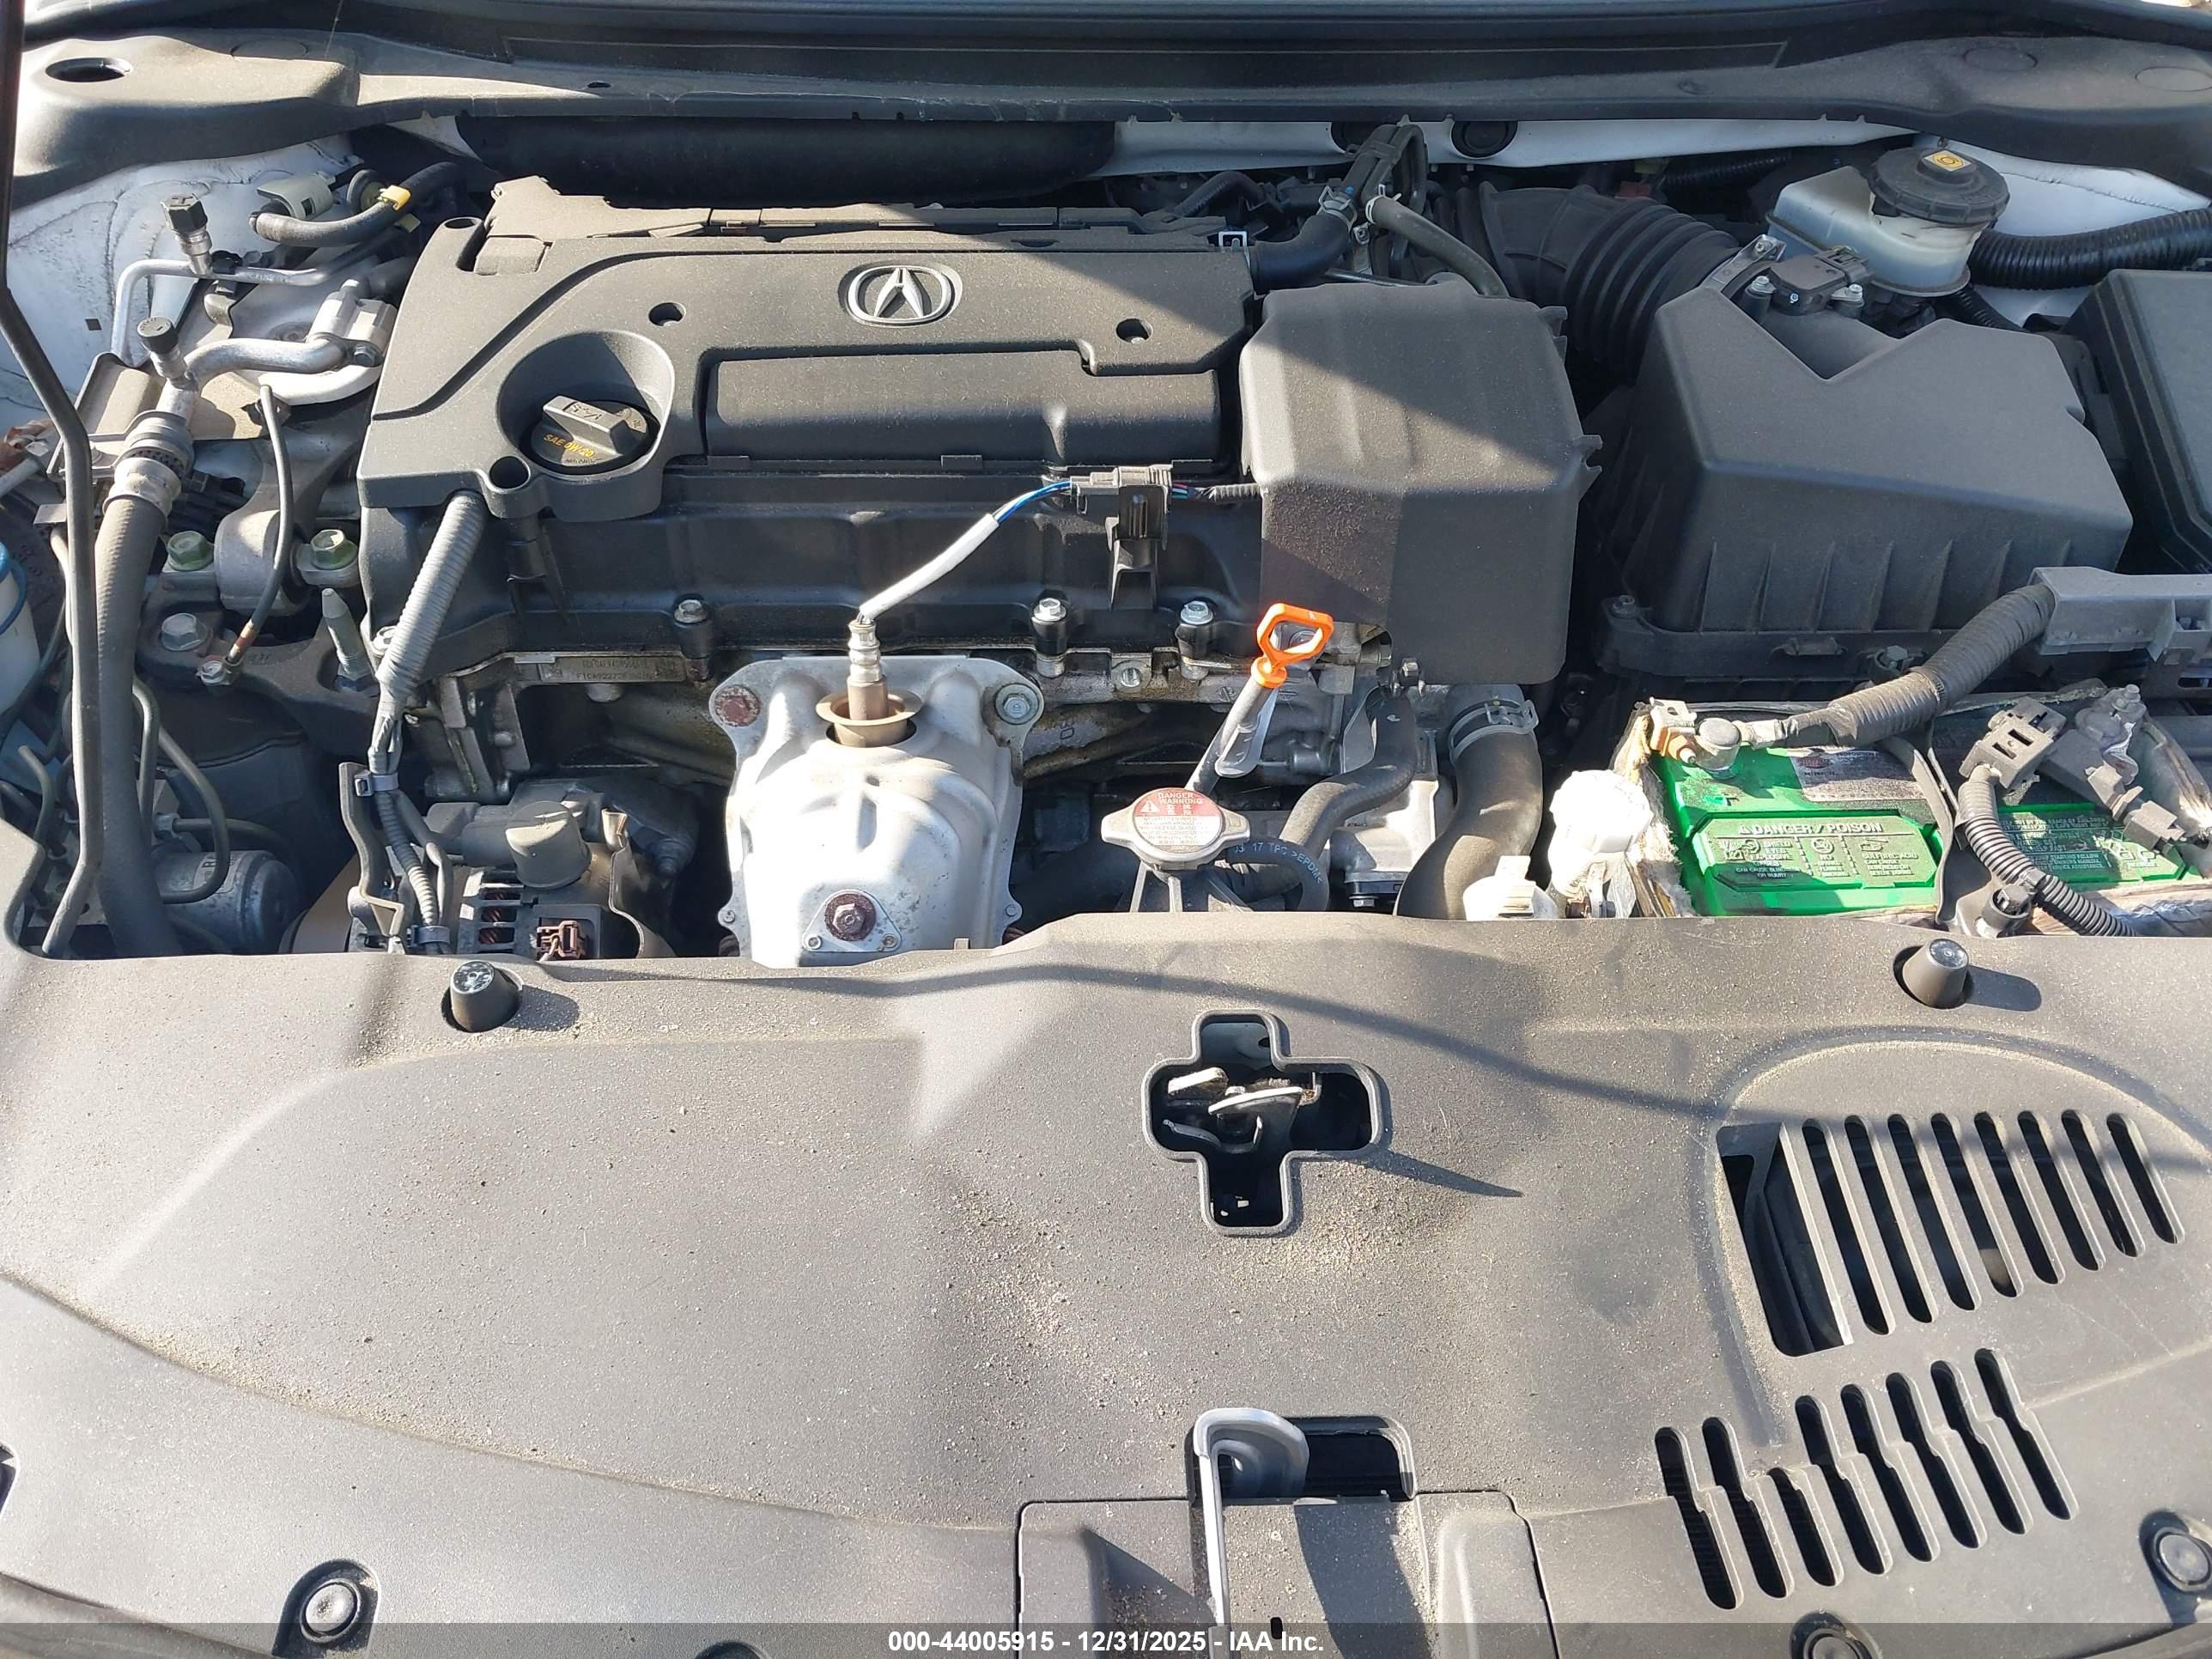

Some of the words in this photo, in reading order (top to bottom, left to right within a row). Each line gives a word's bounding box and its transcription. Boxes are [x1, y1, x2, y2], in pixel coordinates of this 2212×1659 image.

[543, 433, 566, 446] SAE
[1752, 823, 1813, 835] DANGER
[1814, 823, 1824, 834] /
[1826, 822, 1884, 834] POISON
[1252, 842, 1263, 852] 17
